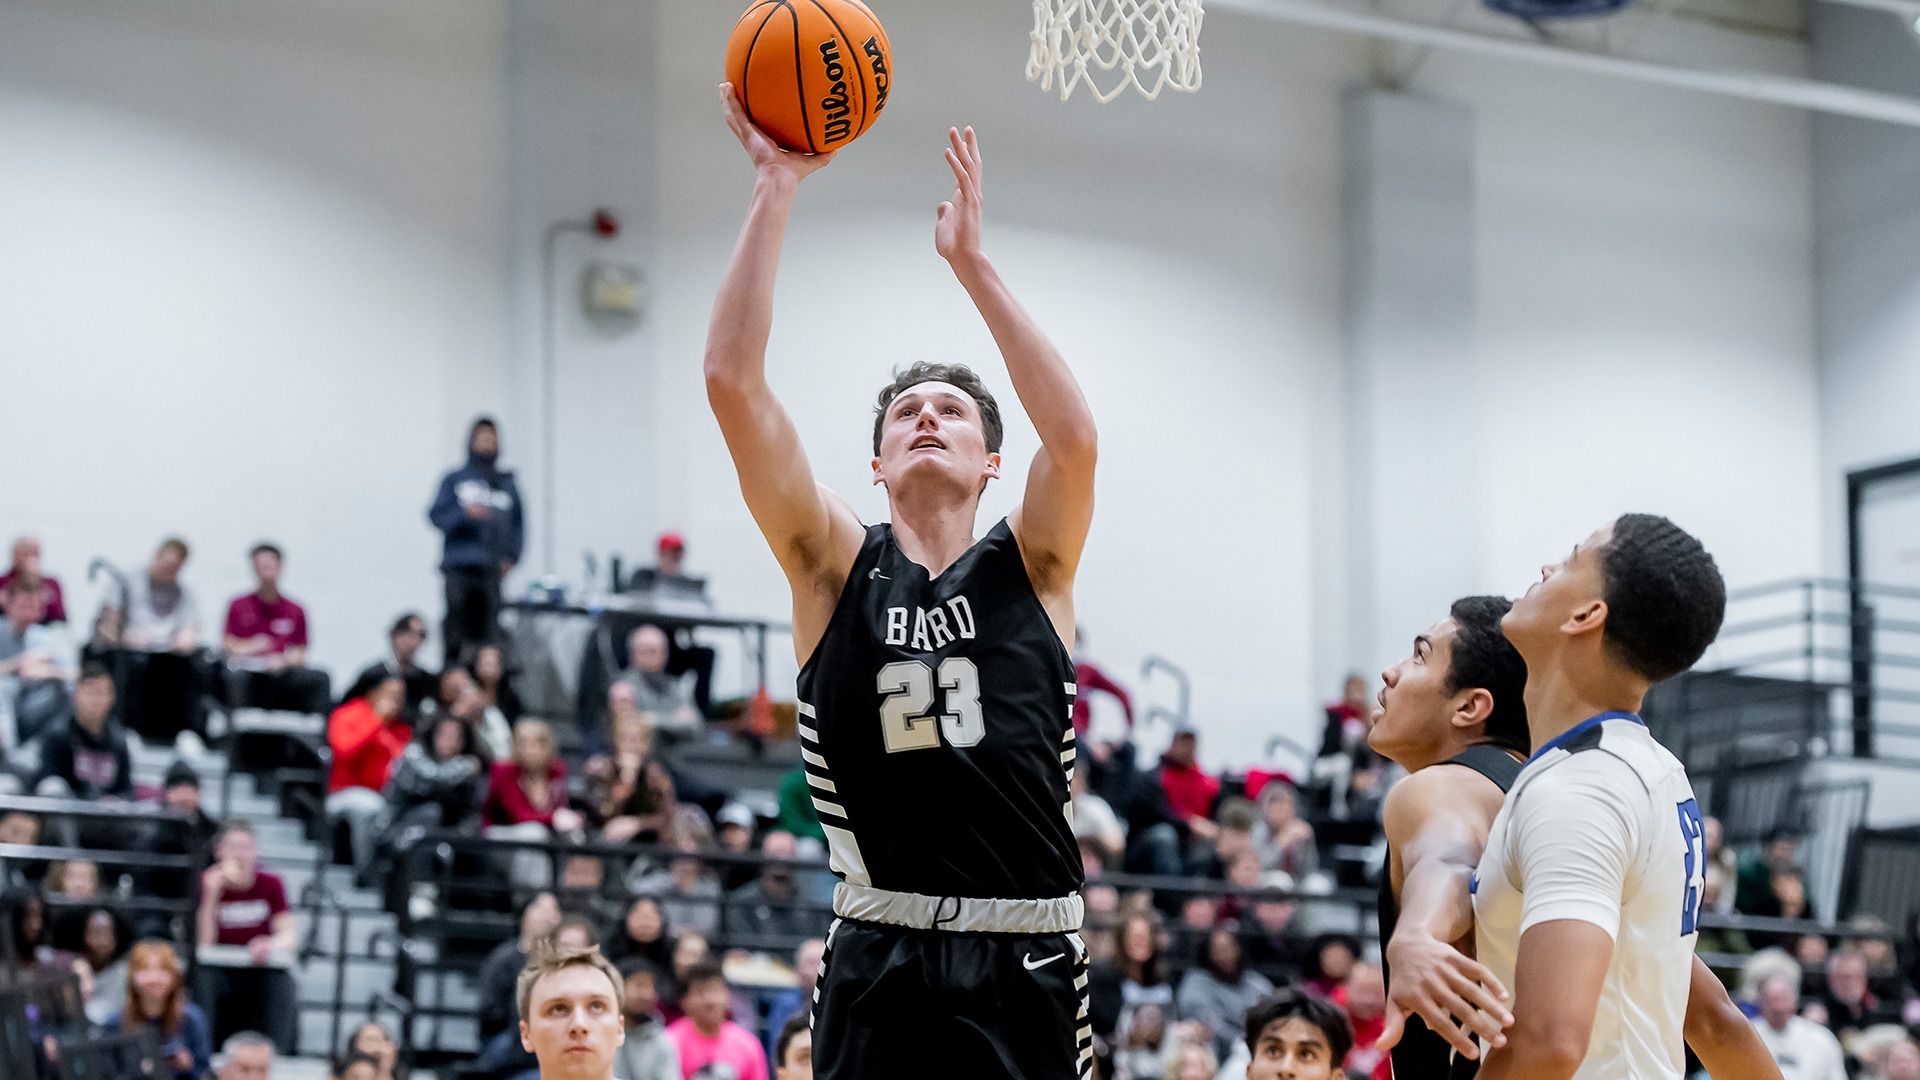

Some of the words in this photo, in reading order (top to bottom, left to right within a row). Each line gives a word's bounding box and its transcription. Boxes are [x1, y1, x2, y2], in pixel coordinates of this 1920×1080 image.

[819, 38, 852, 145] Wilson
[863, 36, 888, 114] NCAA
[885, 595, 976, 651] BARD
[876, 657, 986, 754] 23
